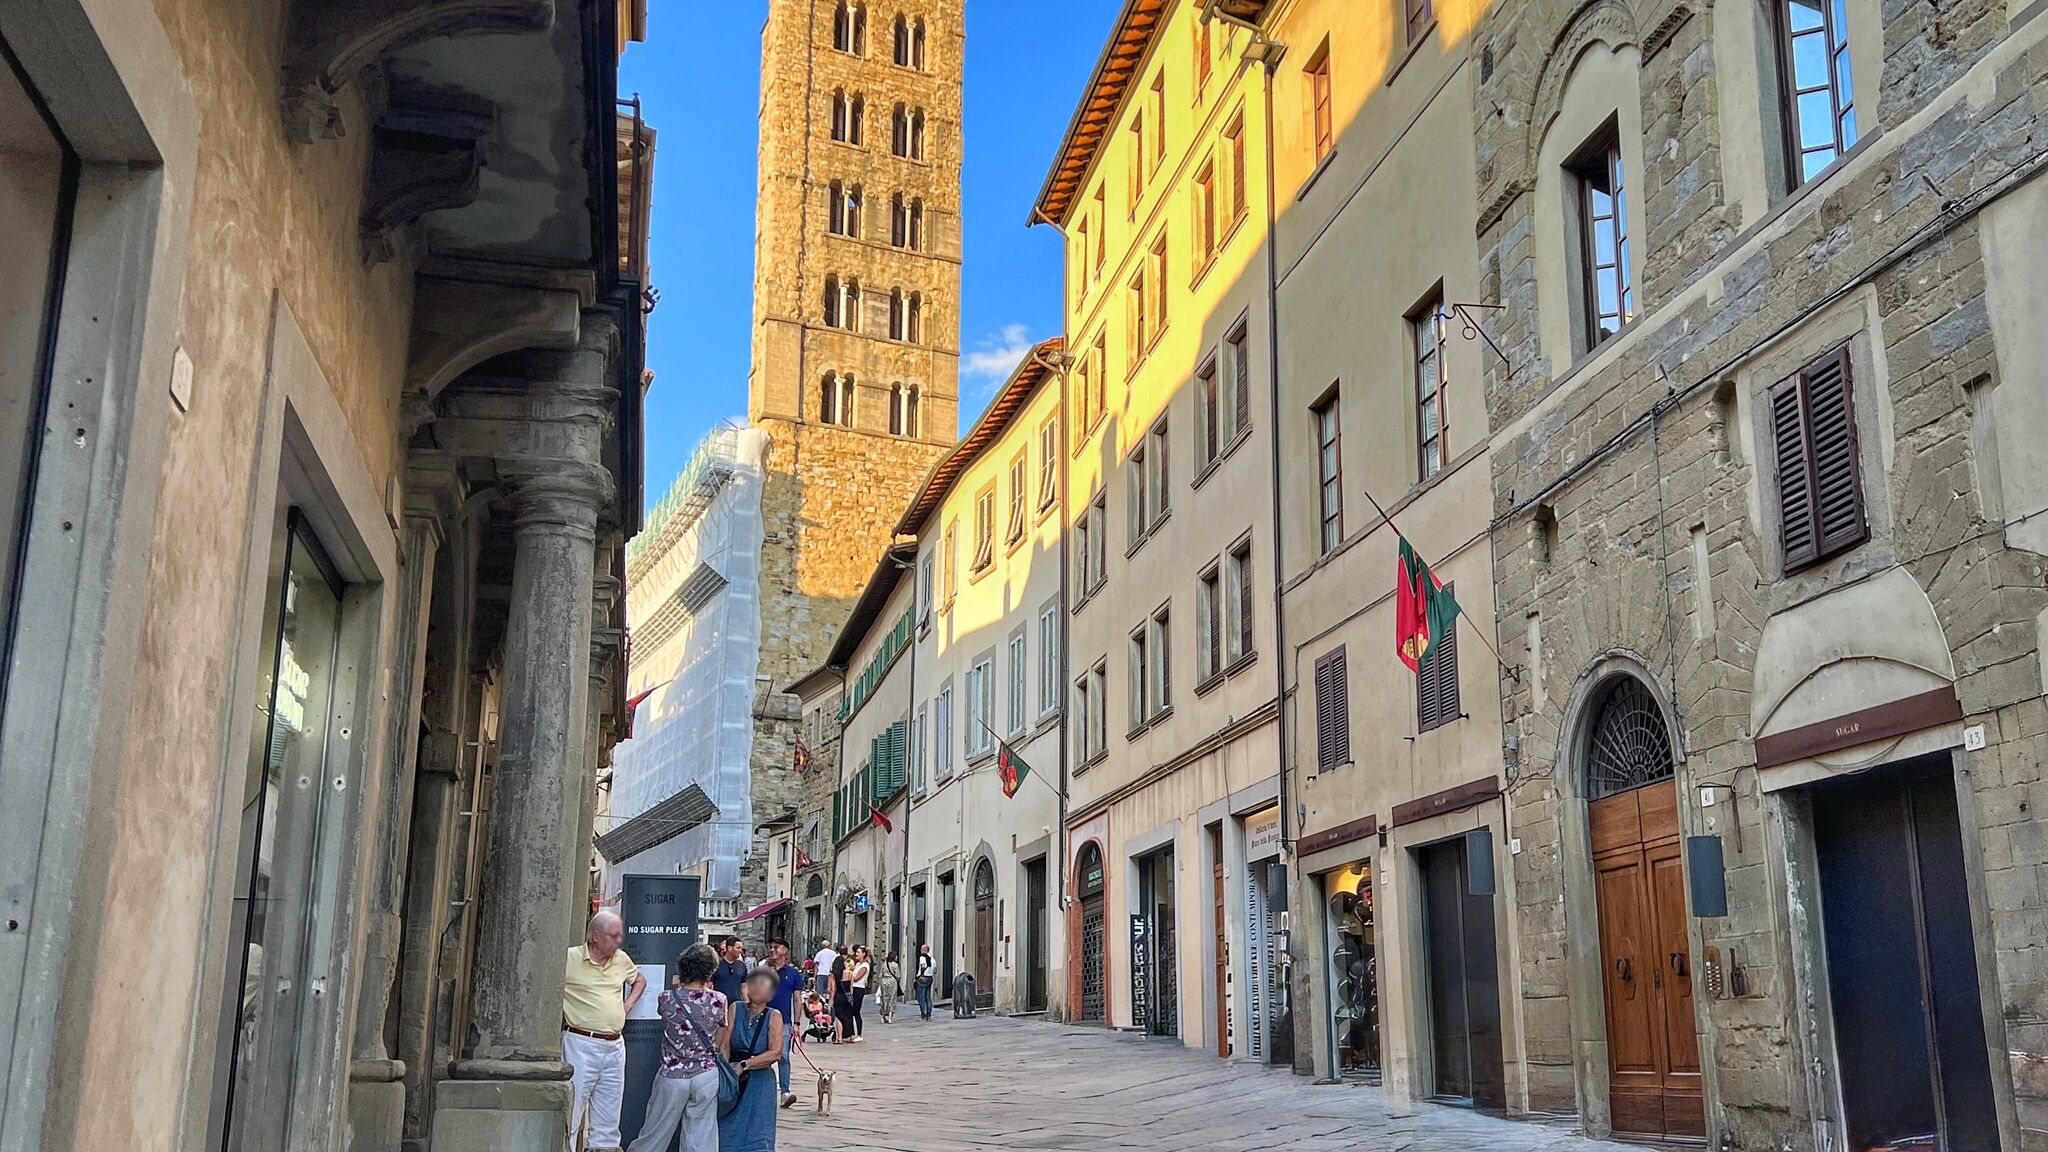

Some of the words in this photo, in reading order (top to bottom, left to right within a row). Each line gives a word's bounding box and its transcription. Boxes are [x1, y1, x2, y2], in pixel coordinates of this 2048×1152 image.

[1835, 723, 1860, 737] SUGAR
[1968, 731, 1981, 746] 43
[644, 893, 675, 904] SUGAR
[628, 926, 639, 934] NO
[640, 926, 664, 934] SUGAR
[665, 926, 689, 934] PLEASE
